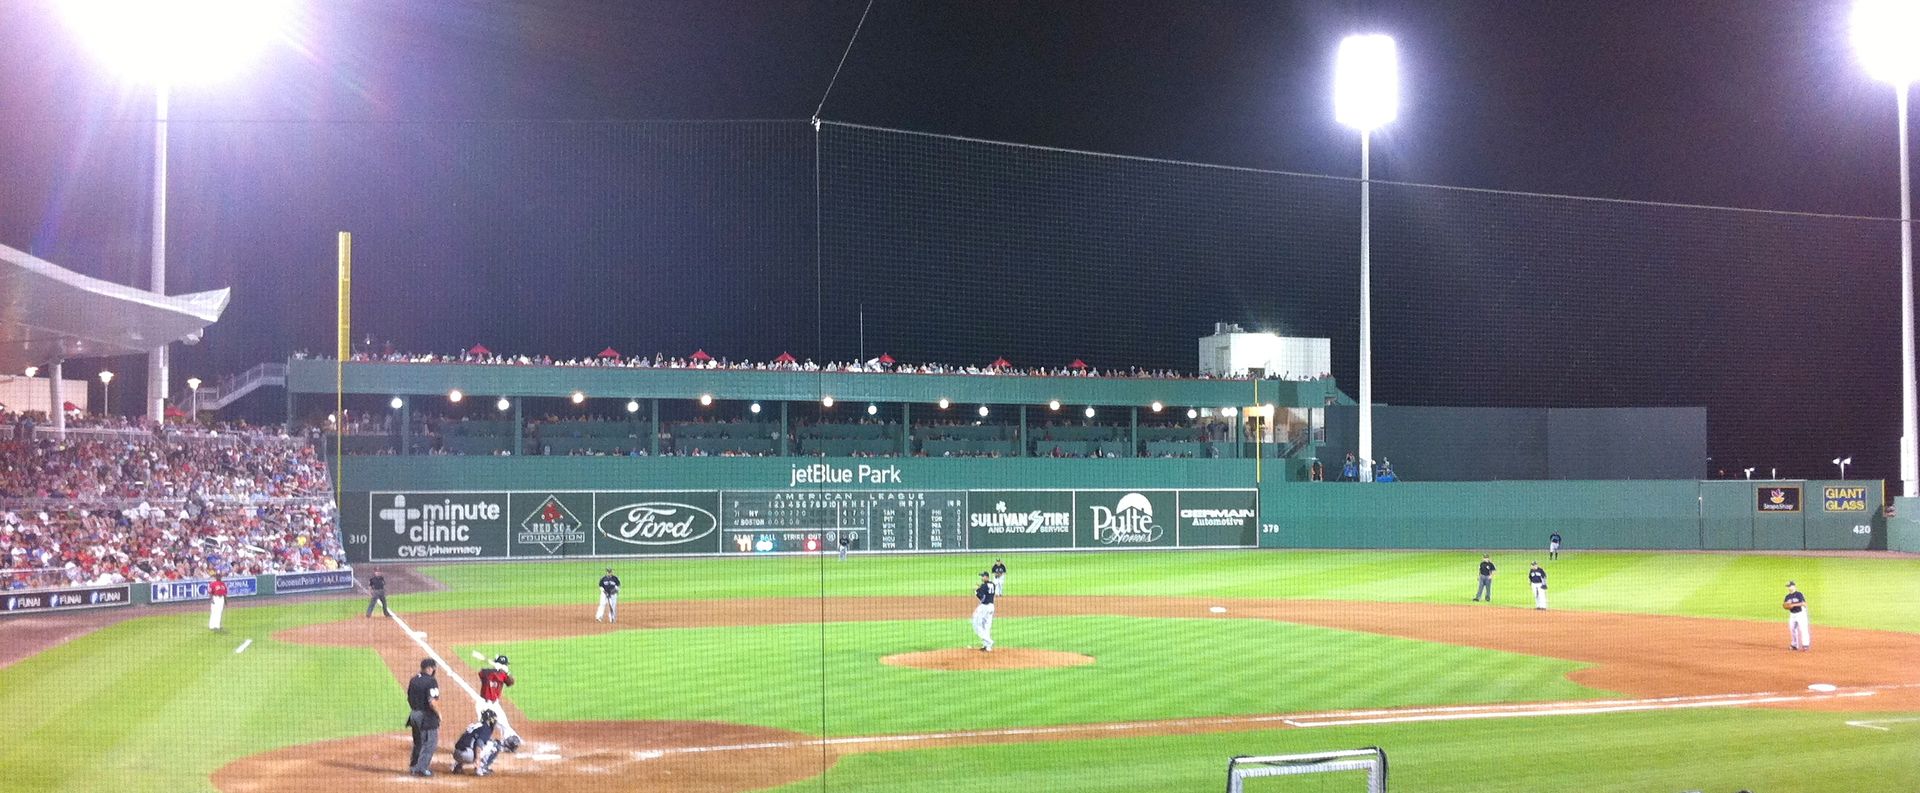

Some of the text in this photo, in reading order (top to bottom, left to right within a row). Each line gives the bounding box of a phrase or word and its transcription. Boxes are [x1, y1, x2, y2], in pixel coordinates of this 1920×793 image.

[790, 463, 902, 487] jetBlue Park
[1826, 488, 1864, 498] GIANT
[423, 499, 501, 520] minute
[1826, 500, 1865, 510] GLASS
[1181, 509, 1255, 518] GERMAIN
[620, 507, 695, 538] Ford
[971, 512, 1069, 527] SULLIVAN TIRE
[1090, 506, 1153, 541] Pulte
[1192, 517, 1244, 526] Automotive
[410, 521, 470, 542] clinic
[533, 523, 552, 533] RED
[988, 526, 1005, 534] AND
[1005, 526, 1026, 534] AUTO
[1263, 525, 1279, 533] 379
[1853, 525, 1871, 533] 420
[349, 535, 367, 544] 310
[520, 534, 583, 542] FOUNDATION
[170, 582, 209, 599] LEHIG
[60, 595, 82, 605] FUNAI
[99, 592, 121, 602] FUNAI
[18, 597, 41, 608] FUNAI
